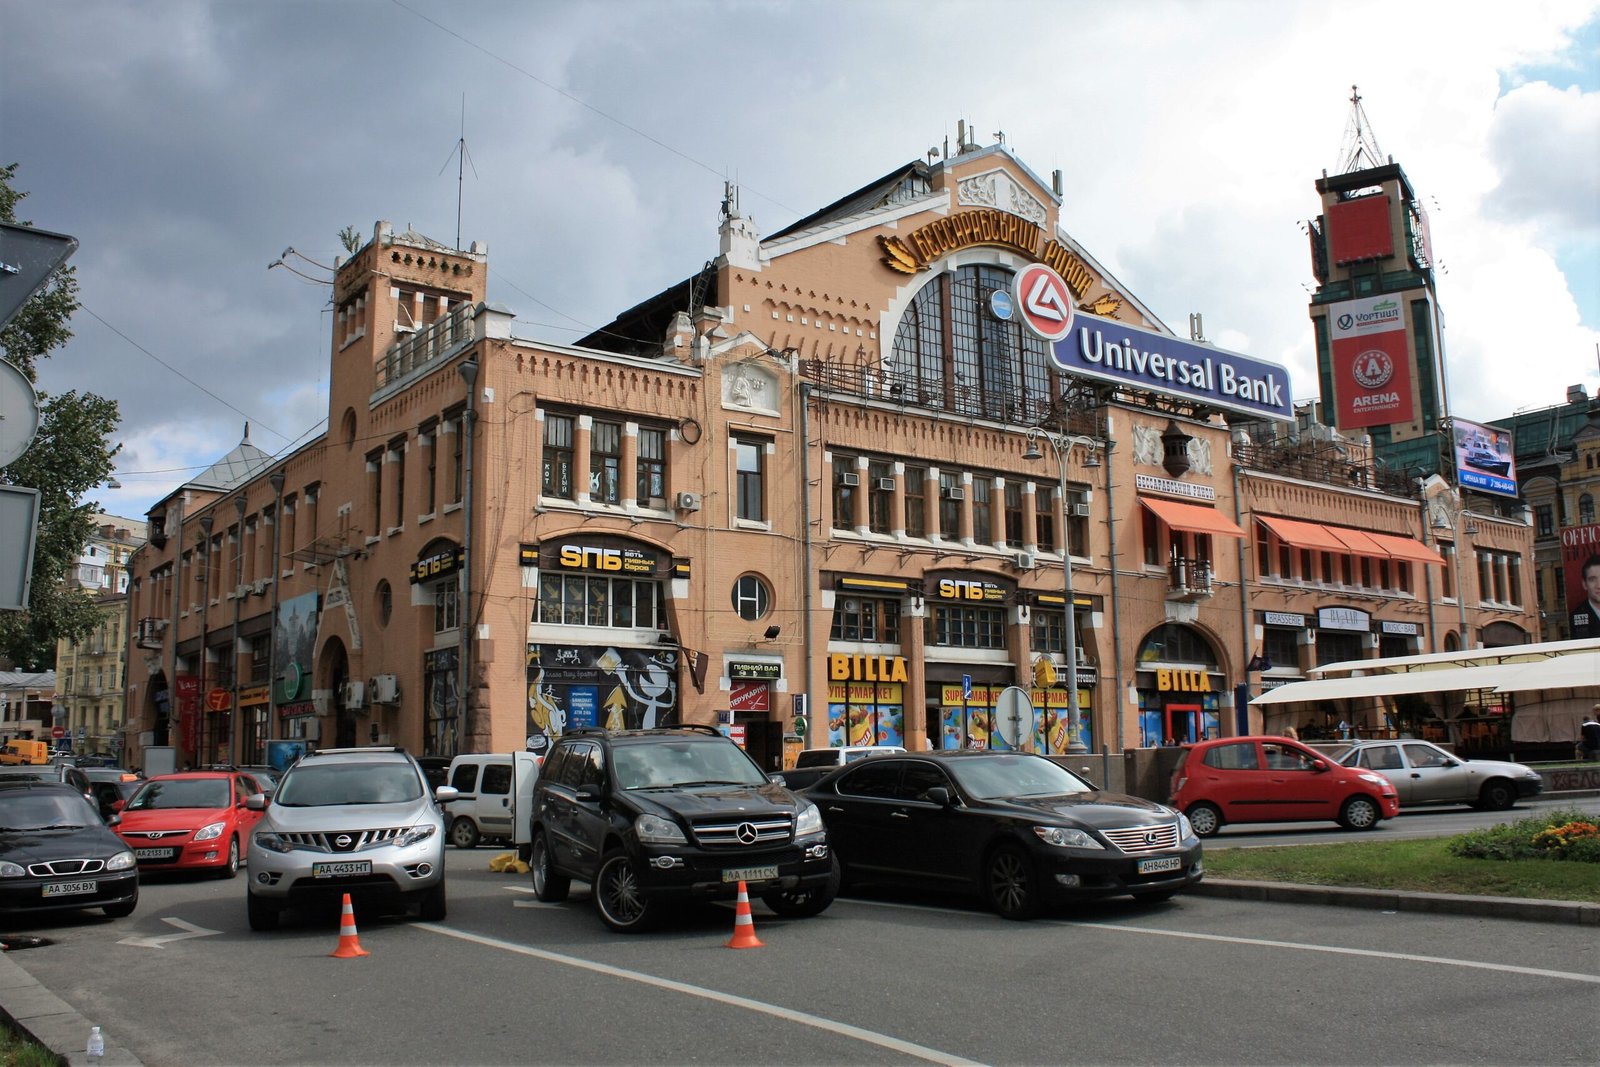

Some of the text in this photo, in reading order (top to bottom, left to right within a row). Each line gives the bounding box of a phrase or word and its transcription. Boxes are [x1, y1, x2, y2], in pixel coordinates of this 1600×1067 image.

[912, 209, 1094, 299] БЕССАРАБСЬКИЙ РИНОК
[1079, 326, 1284, 408] Universal Bank
[1353, 392, 1400, 407] ARENA
[1353, 402, 1400, 414] ENTERTAINMENT
[1268, 613, 1302, 626] BRASSERIE
[832, 653, 908, 682] BILLA
[1157, 669, 1211, 692] BILLA
[828, 686, 893, 699] УПЕРМАРКЕТ
[945, 689, 1001, 703] SUPEMARKE
[1030, 690, 1083, 703] УПЕРМАРТ
[320, 863, 368, 874] AA 4433 HT
[743, 870, 762, 878] 1111
[48, 882, 94, 893] AA 3056 BX
